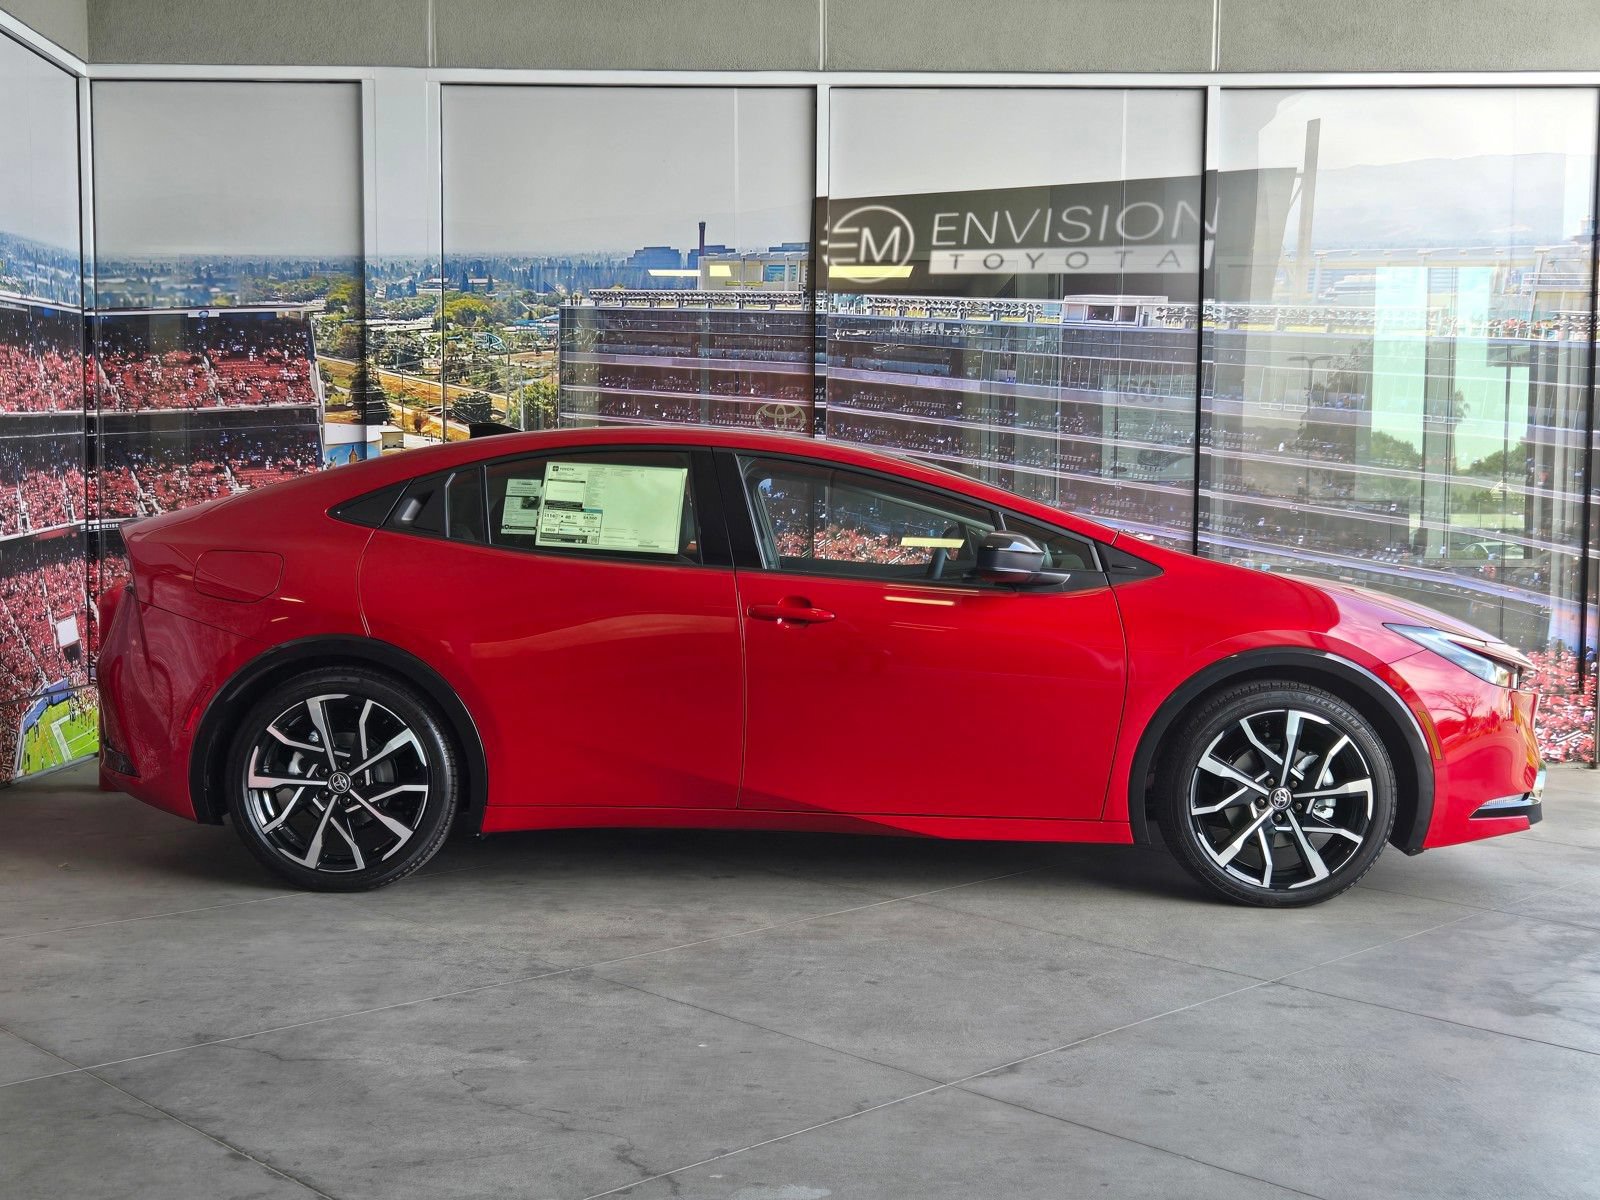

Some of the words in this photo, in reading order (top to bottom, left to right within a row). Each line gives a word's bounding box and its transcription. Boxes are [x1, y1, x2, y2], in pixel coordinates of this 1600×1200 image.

[932, 198, 1220, 245] ENVISION
[949, 250, 1183, 271] TOYOTA
[1306, 695, 1361, 730] MICHELIN
